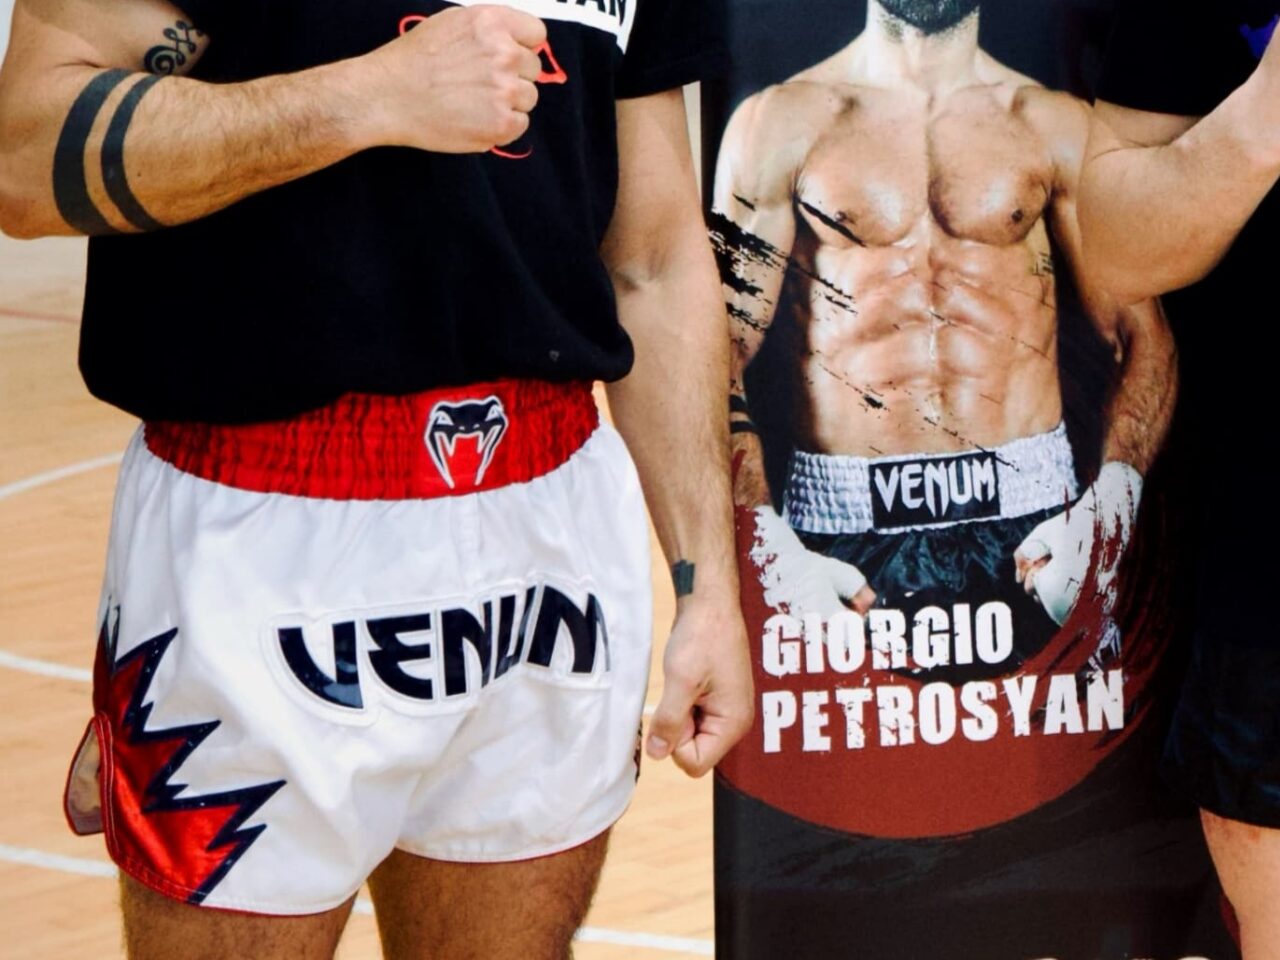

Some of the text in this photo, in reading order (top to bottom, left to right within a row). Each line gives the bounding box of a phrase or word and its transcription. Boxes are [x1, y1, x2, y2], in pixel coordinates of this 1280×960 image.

[875, 458, 995, 517] VENUM
[762, 601, 1013, 677] GIORGIO
[762, 669, 1125, 753] PETROSYAN
